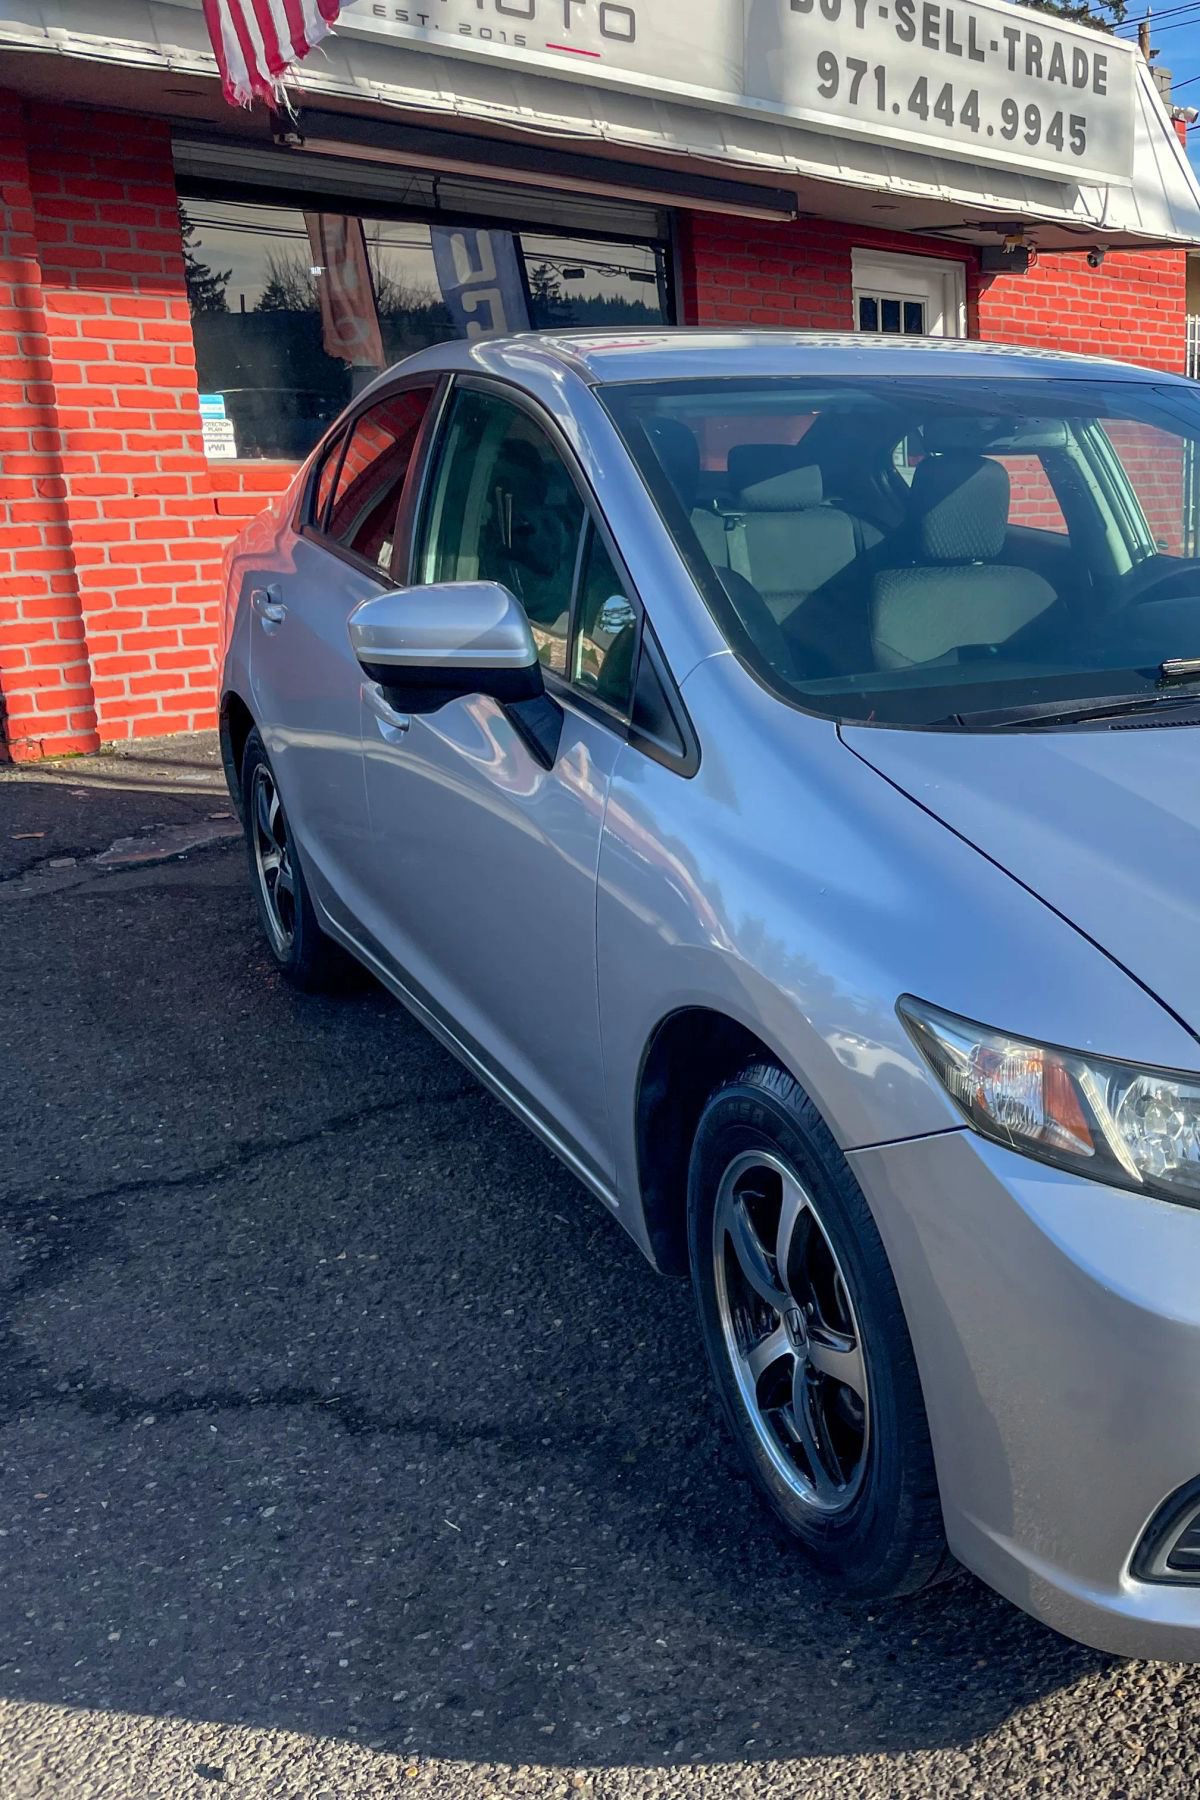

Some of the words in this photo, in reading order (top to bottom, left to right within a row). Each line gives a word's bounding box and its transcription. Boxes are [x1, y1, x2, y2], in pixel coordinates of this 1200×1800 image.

[372, 4, 440, 29] EST.
[458, 23, 527, 47] 2015
[790, 0, 1108, 97] Y-SELL-TRADE
[816, 50, 1088, 156] 971.444.9945
